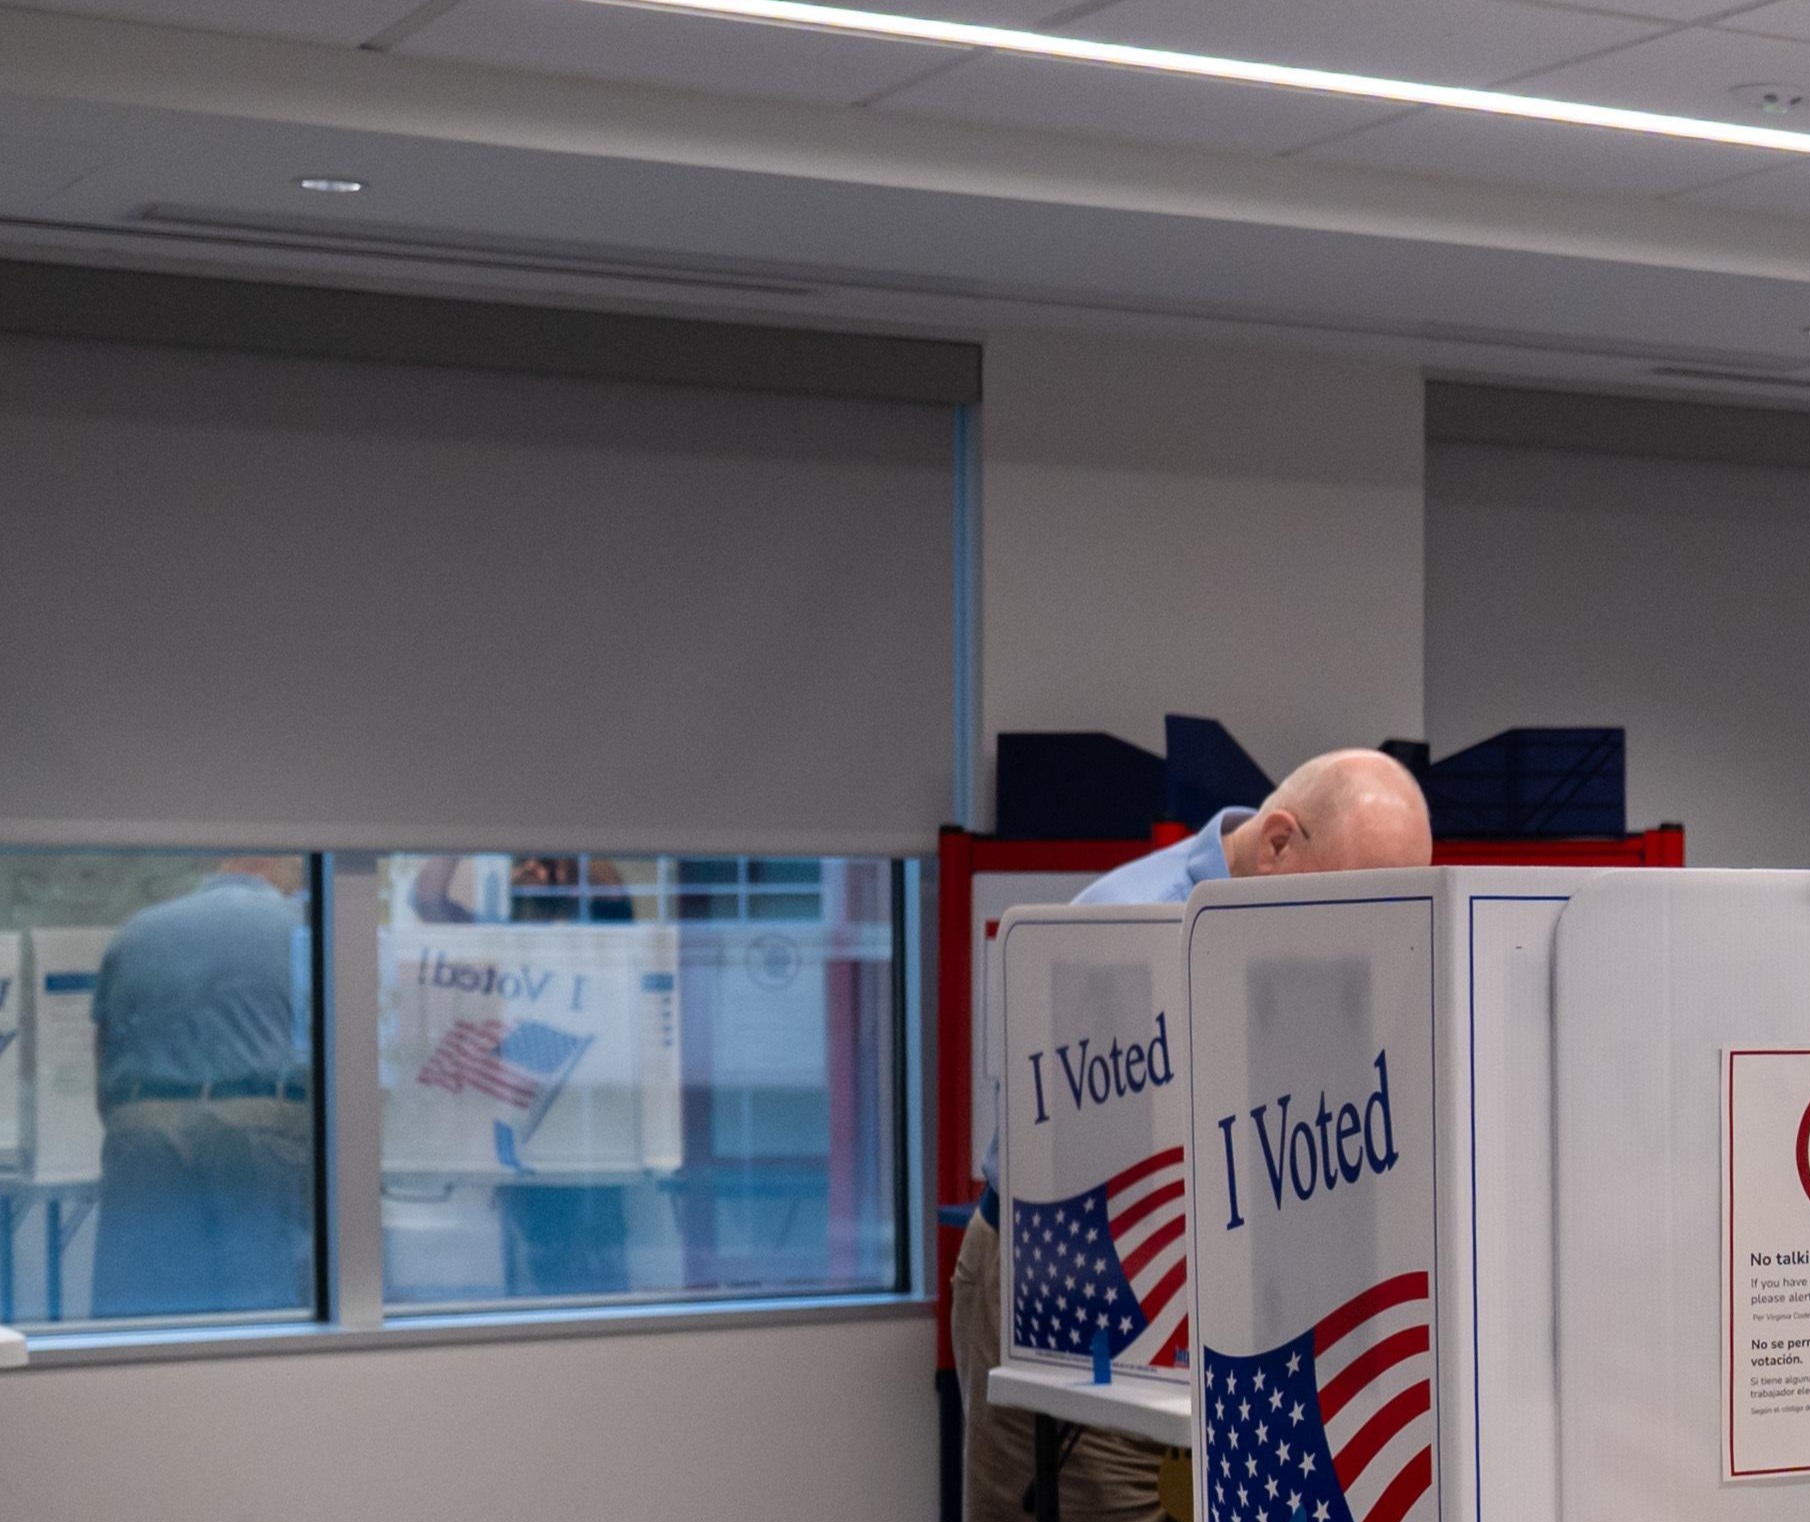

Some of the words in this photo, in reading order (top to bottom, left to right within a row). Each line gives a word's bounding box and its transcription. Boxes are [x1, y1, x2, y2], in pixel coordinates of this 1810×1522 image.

[1029, 1052, 1050, 1125] I
[1055, 1011, 1174, 1111] Voted
[1217, 1114, 1245, 1232] I
[1250, 1049, 1400, 1212] Voted
[1750, 1252, 1772, 1266] No
[1751, 1278, 1759, 1288] If
[1761, 1279, 1780, 1290] you
[1783, 1276, 1807, 1287] have
[1751, 1292, 1785, 1306] please
[1751, 1339, 1768, 1350] No
[1771, 1340, 1784, 1349] se
[1751, 1354, 1803, 1367] votación.
[1750, 1376, 1759, 1386] Si
[1761, 1375, 1782, 1386] tiene
[1750, 1389, 1794, 1399] trabajador
